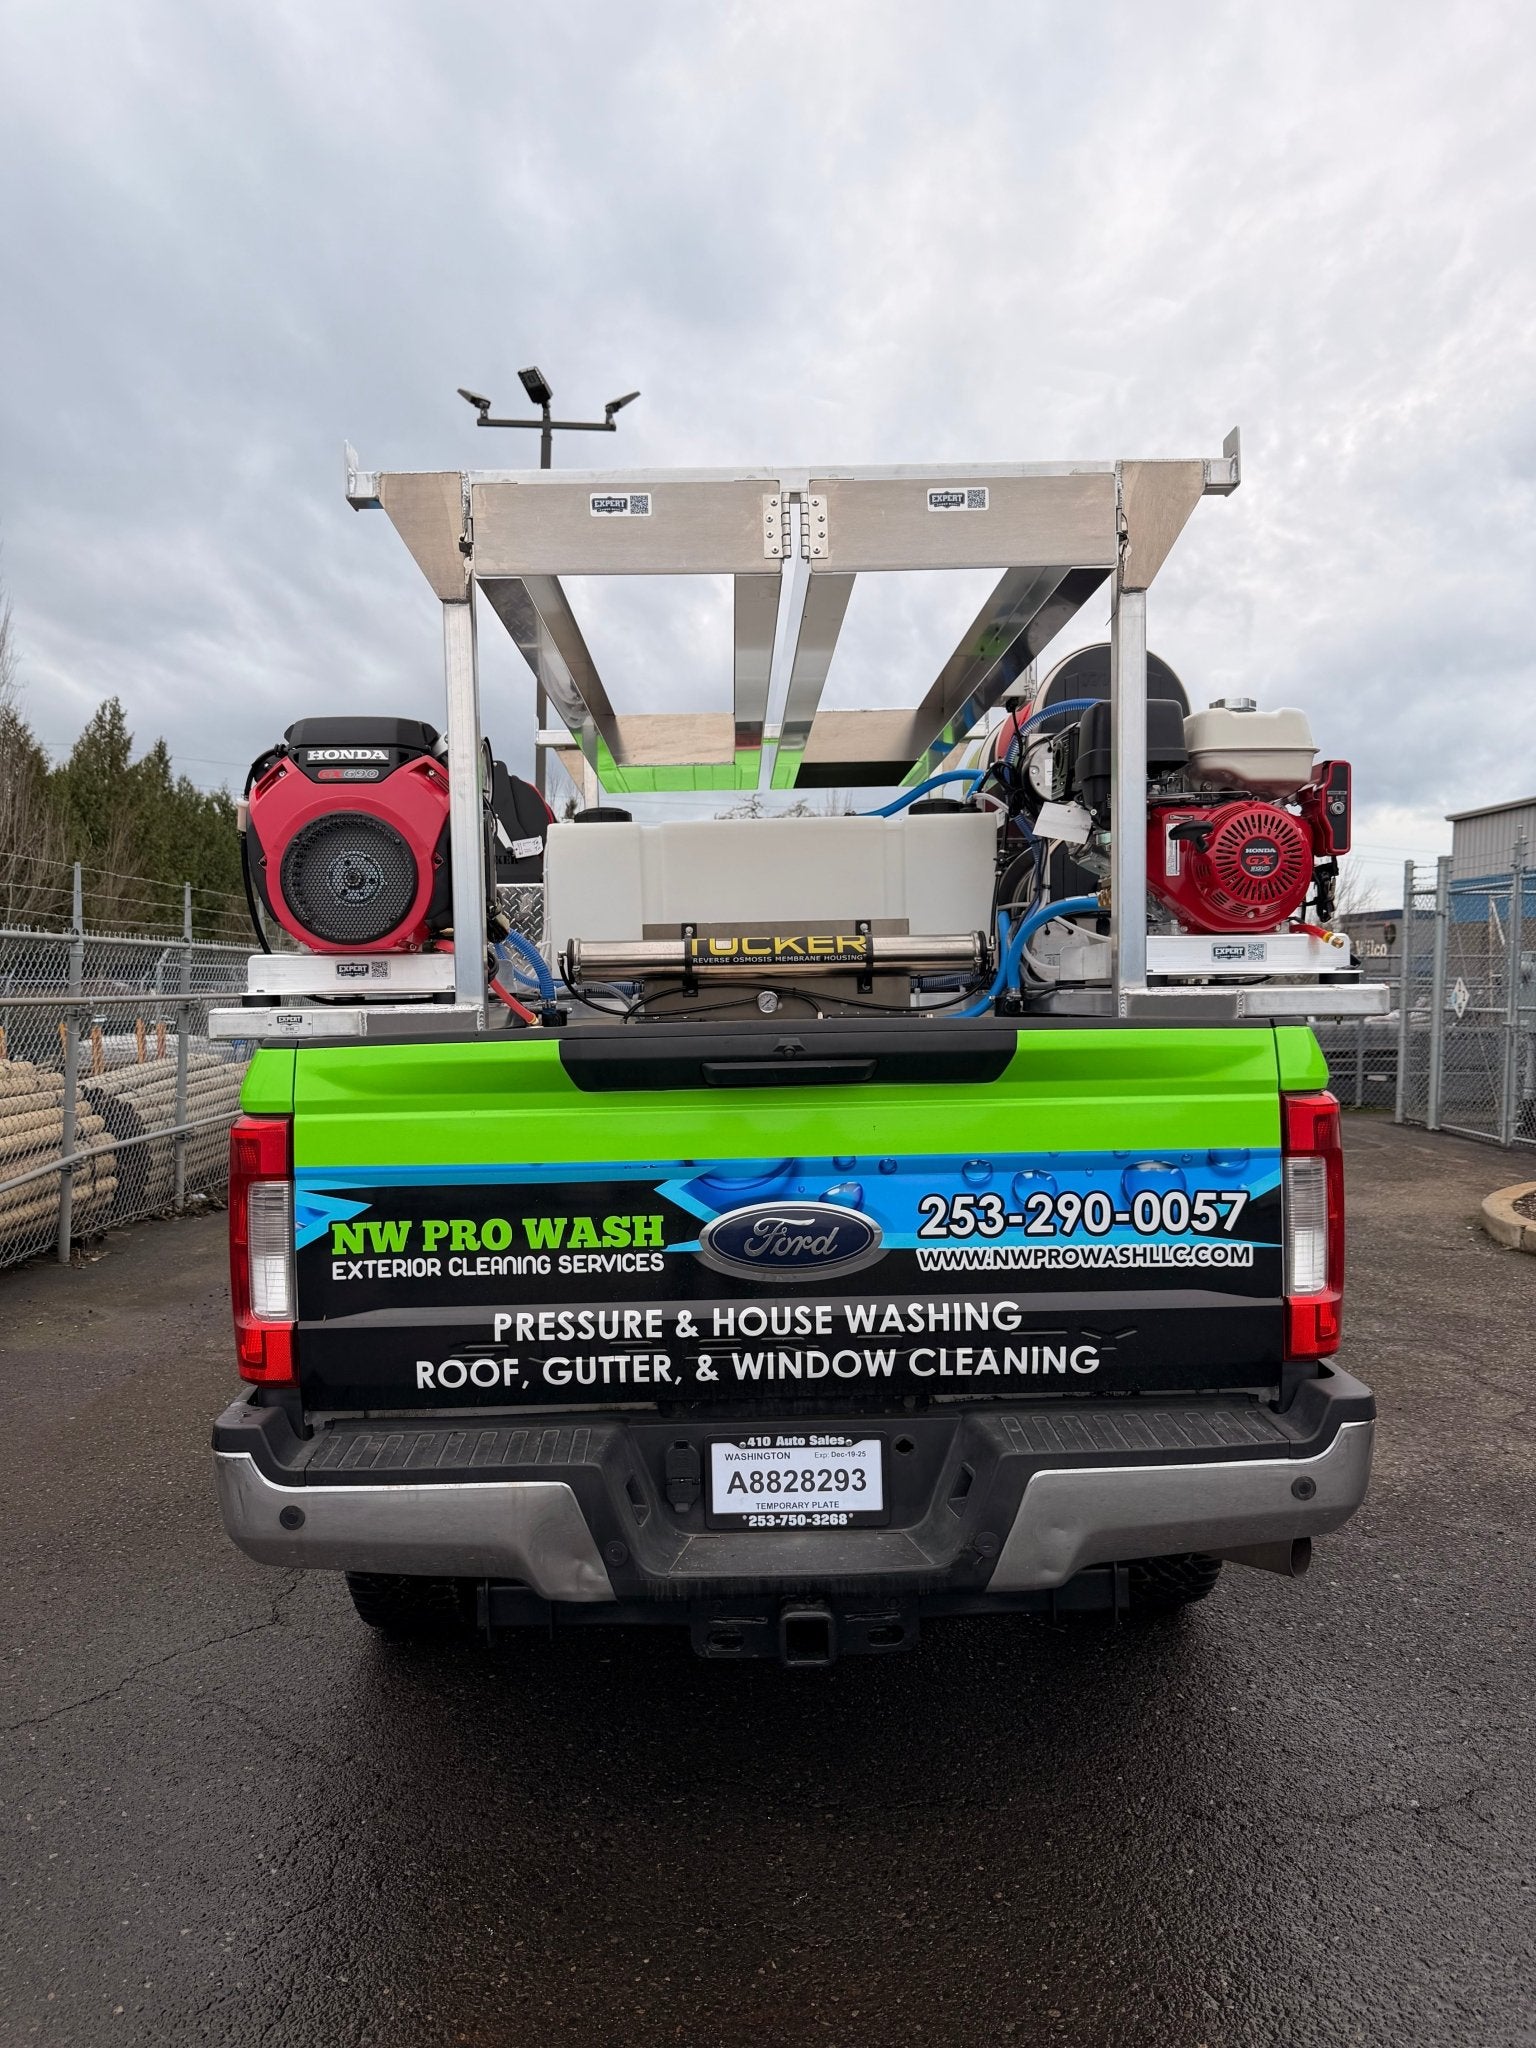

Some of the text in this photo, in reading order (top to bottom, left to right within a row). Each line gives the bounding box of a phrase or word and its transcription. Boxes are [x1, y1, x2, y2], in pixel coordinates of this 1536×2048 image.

[932, 494, 962, 502] EXPERT
[307, 750, 389, 760] HONDA
[1246, 855, 1274, 865] GX
[691, 935, 867, 955] TUCKER
[1215, 947, 1244, 955] EXPERT
[918, 1190, 1249, 1237] 253-290-0057
[331, 1214, 664, 1255] NW PRO WASH
[743, 1217, 840, 1257] Ford
[331, 1257, 442, 1280] EXTERIOR
[557, 1251, 665, 1274] SERVICES
[917, 1244, 1253, 1269] WWW.NWPROWASHLLC.COM
[493, 1300, 1023, 1342] PRESSURE & HOUSE WASHING
[416, 1358, 530, 1390] ROOF,
[542, 1354, 683, 1386] GUTTER,
[695, 1353, 720, 1382] &
[731, 1348, 897, 1381] WINDOW
[909, 1344, 1100, 1378] CLEANING
[747, 1434, 845, 1447] 410 Auto Sales
[725, 1451, 791, 1461] WASHINGTON
[831, 1450, 867, 1458] Dec-19-25
[726, 1467, 867, 1495] A8828293
[756, 1500, 840, 1510] TEMPORARY PLATE
[748, 1513, 848, 1527] 253-750-3268
